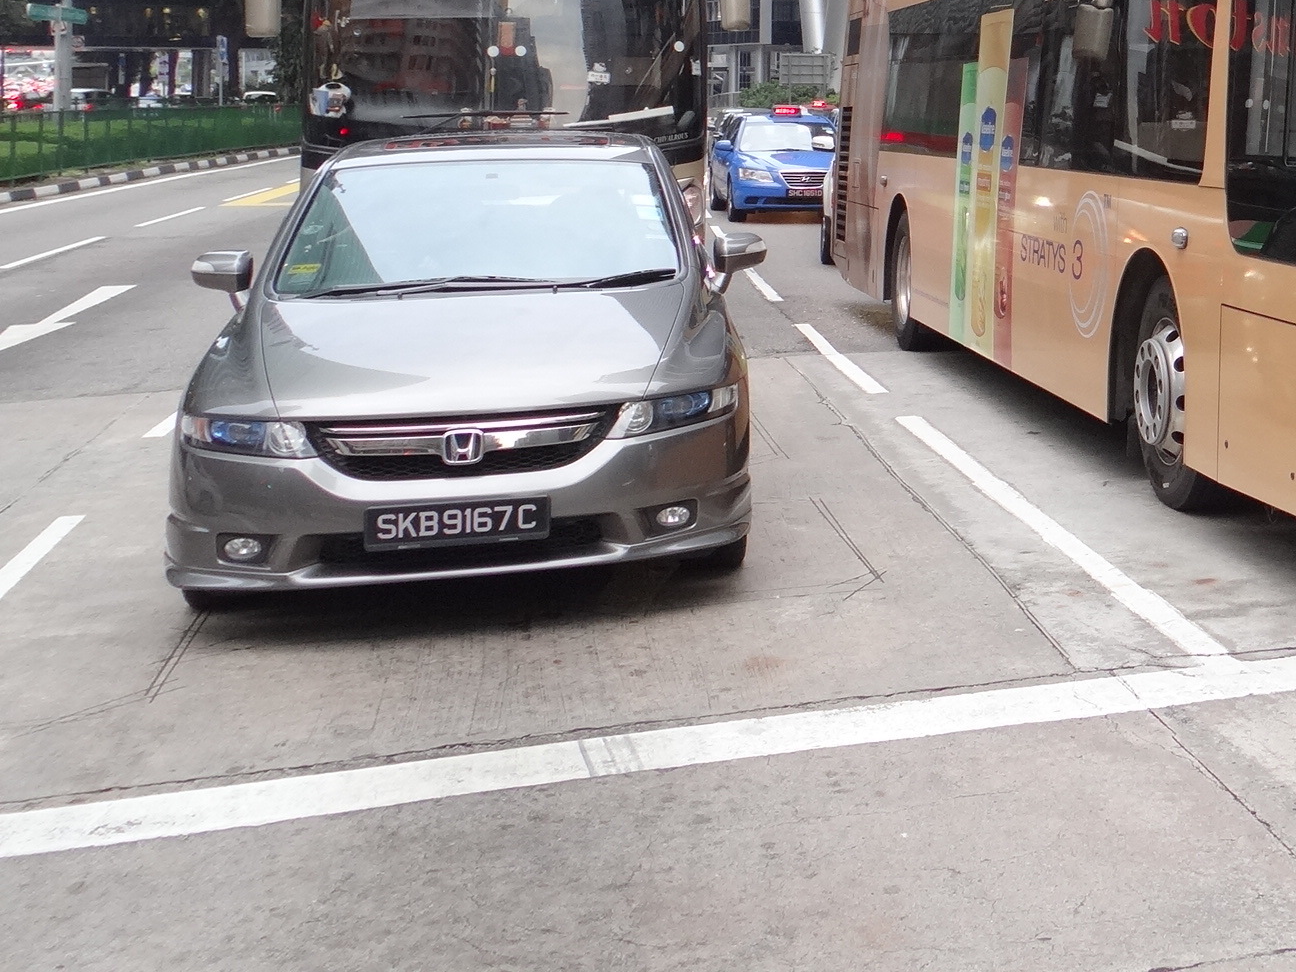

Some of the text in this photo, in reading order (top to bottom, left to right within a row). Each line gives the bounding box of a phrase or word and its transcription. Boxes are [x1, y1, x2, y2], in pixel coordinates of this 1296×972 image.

[1021, 233, 1084, 280] STRATYS 3
[376, 504, 537, 540] SKB9167C
